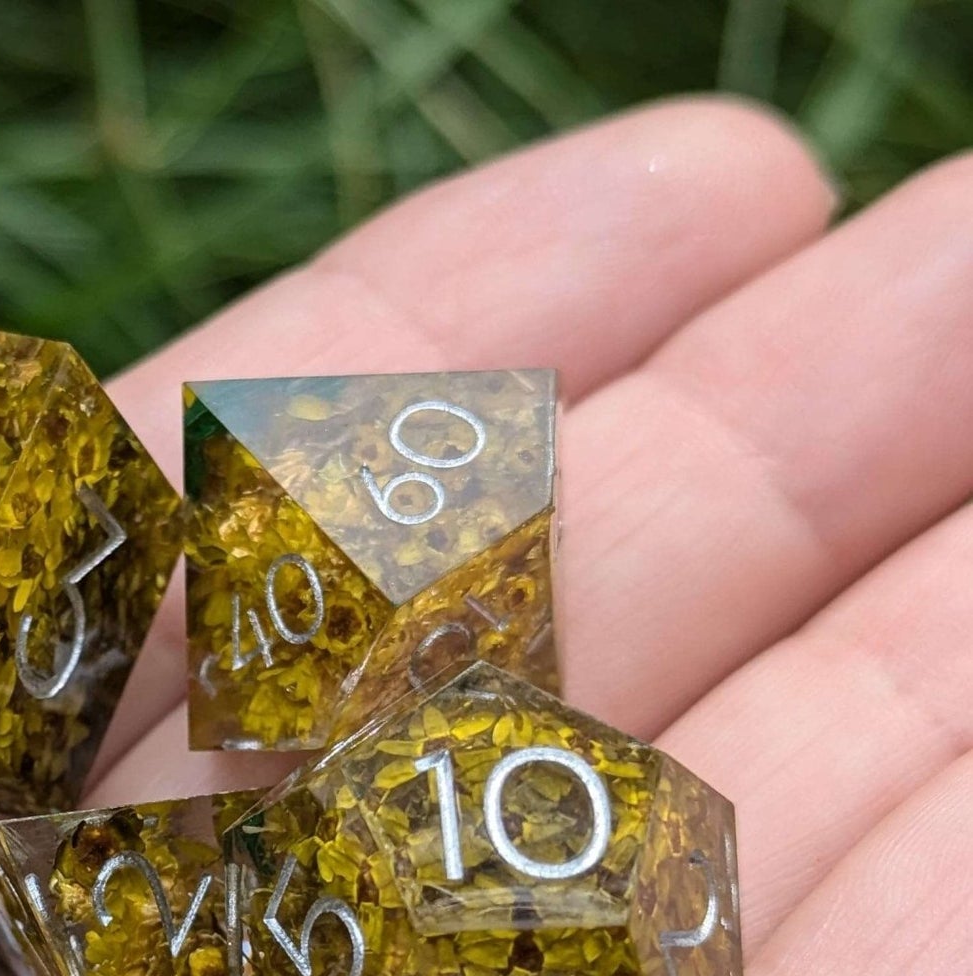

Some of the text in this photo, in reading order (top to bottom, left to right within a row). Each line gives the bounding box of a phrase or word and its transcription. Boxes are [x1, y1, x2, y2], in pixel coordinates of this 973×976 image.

[230, 552, 324, 671] 40
[413, 746, 613, 881] 10
[93, 850, 212, 958] 2
